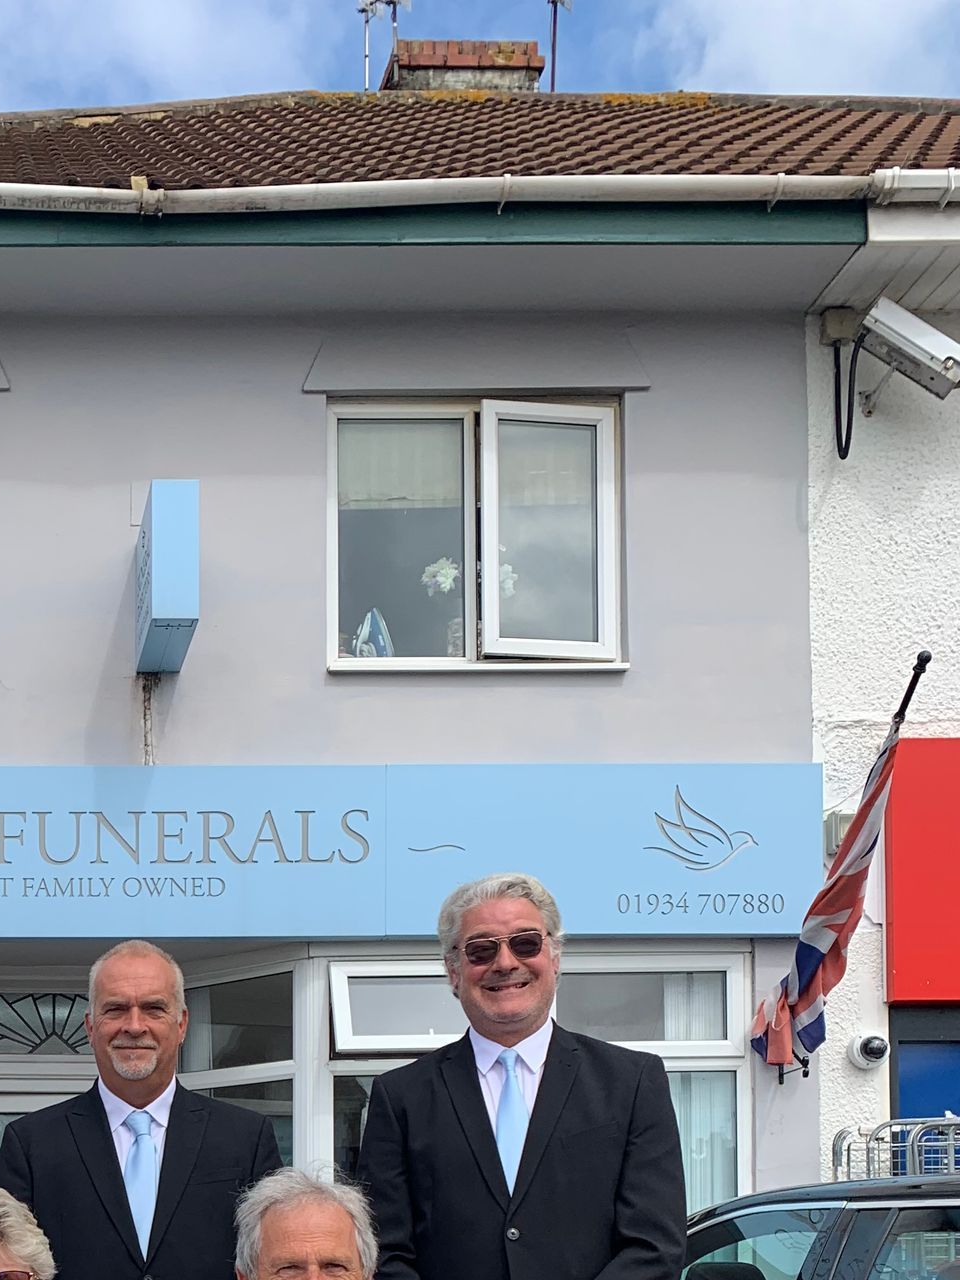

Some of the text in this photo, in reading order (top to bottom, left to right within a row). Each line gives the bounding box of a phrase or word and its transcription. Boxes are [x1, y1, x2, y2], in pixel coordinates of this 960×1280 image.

[22, 876, 115, 898] FAMILY
[121, 876, 227, 898] OWNED
[617, 891, 785, 915] 01934 707880
